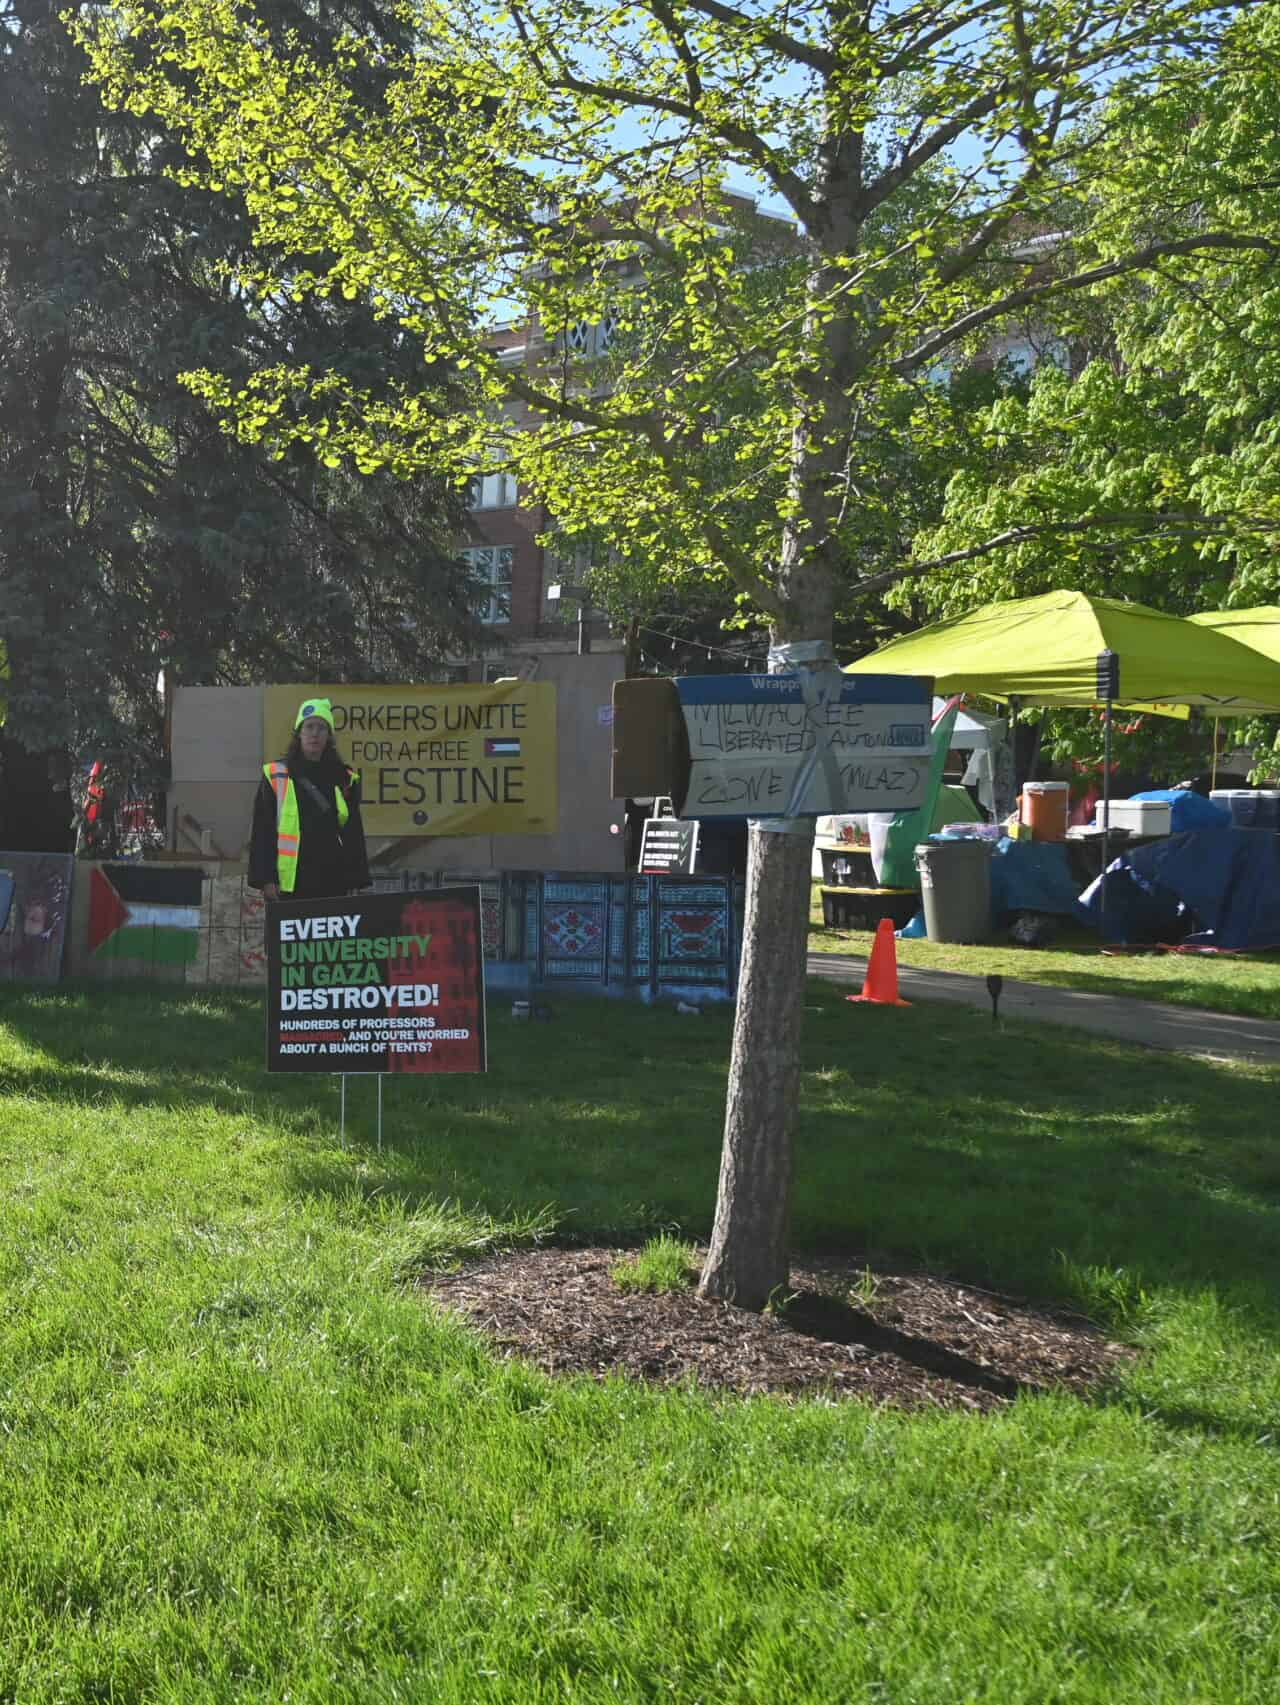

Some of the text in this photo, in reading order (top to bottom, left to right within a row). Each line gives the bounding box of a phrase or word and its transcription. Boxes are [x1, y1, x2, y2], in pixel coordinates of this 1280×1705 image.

[331, 703, 528, 731] ORKERS UNITE
[351, 740, 471, 762] FOR A FREE
[358, 765, 526, 805] LESTINE
[697, 768, 785, 804] ZONE
[279, 914, 362, 942] EVERY
[280, 934, 433, 965] UNIVERSITY
[281, 962, 382, 987] IN GAZA
[280, 983, 440, 1011] DESTROYED!
[280, 1017, 436, 1031] HUNDREDS OF PROFESSORS
[348, 1031, 372, 1042] AND
[374, 1030, 415, 1041] YOU'RE
[416, 1029, 470, 1040] WORRIED
[280, 1042, 433, 1055] ABOUT A BUNCH OF TENTS?
